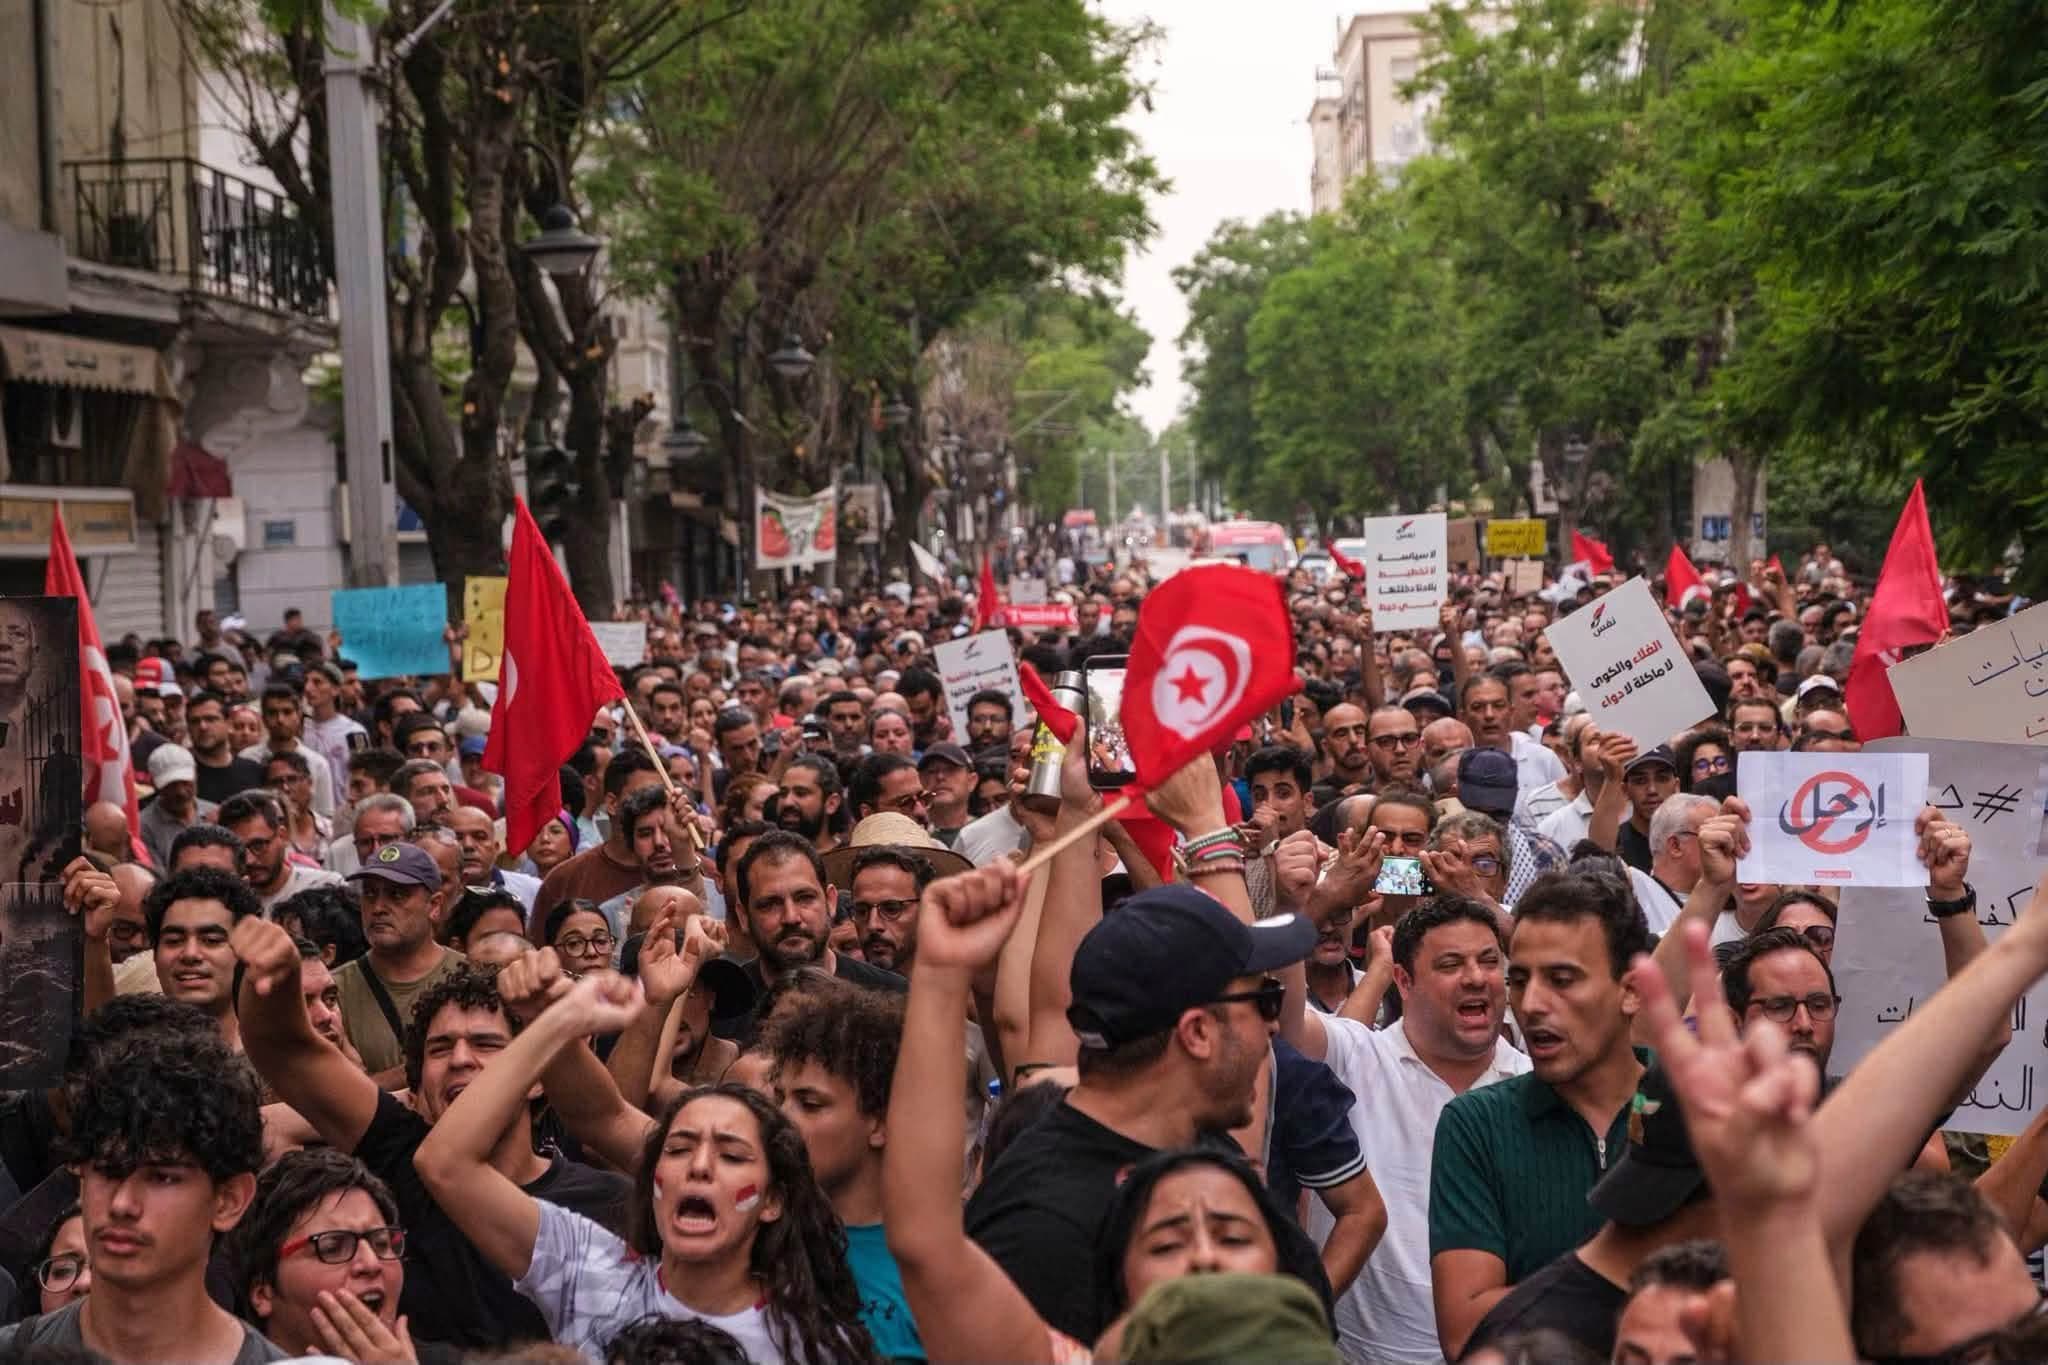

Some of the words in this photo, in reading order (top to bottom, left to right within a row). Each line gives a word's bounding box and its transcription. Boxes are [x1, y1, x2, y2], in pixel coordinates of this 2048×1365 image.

[1377, 551, 1429, 562] سياسة
[1430, 549, 1437, 559] لا
[1430, 565, 1437, 575] لا
[1592, 617, 1617, 638] نفس
[1590, 658, 1634, 689] والكوى
[1665, 657, 1675, 673] لا
[1633, 666, 1666, 690] ماكلة
[1623, 682, 1633, 696] لا
[1600, 690, 1626, 709] دواء
[1779, 781, 1888, 836] إرحل
